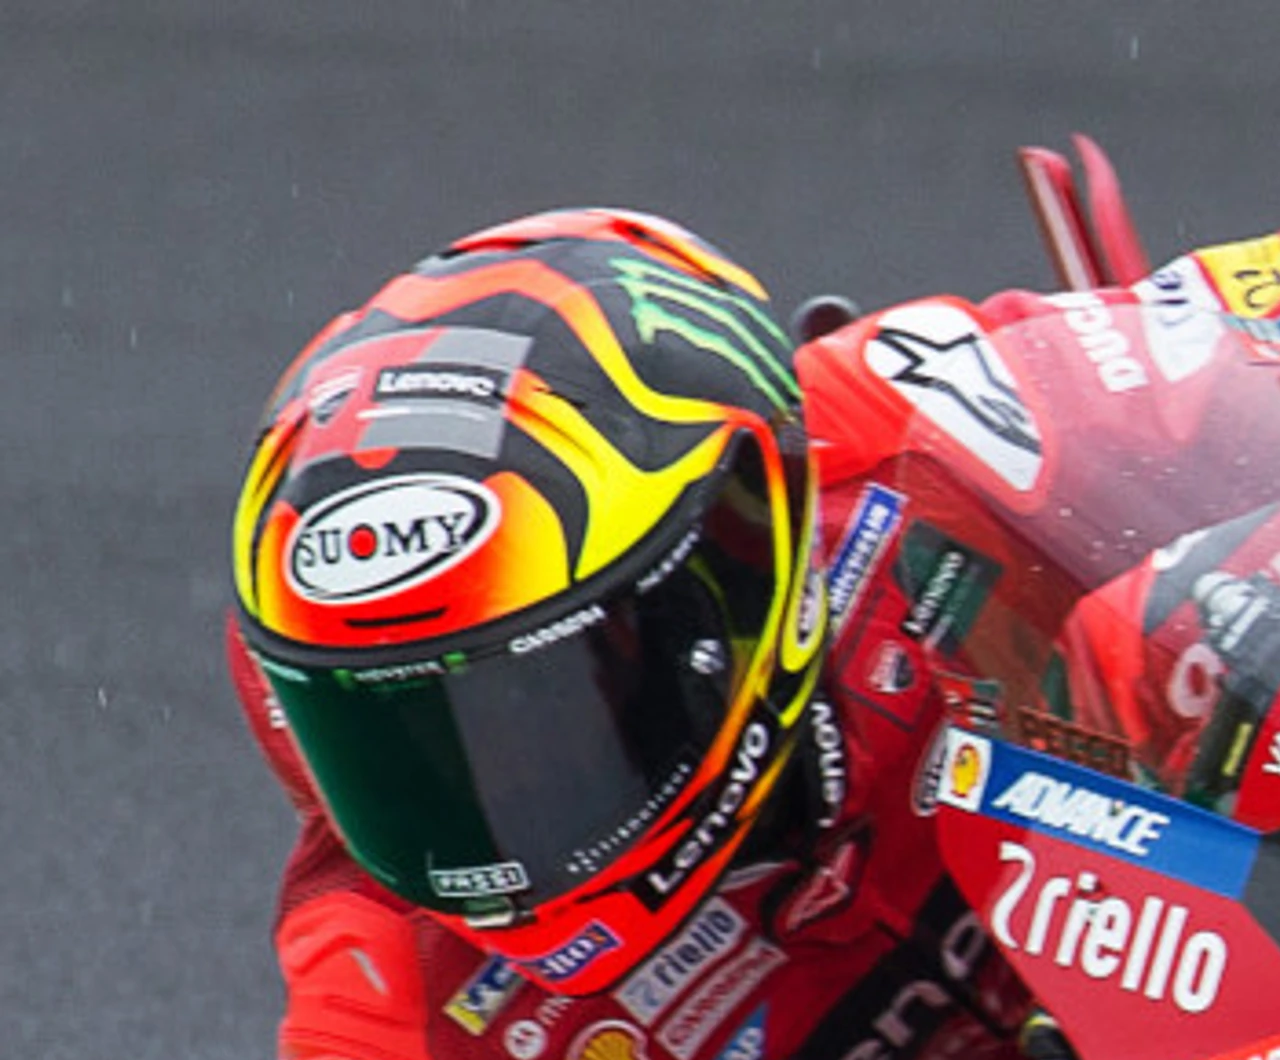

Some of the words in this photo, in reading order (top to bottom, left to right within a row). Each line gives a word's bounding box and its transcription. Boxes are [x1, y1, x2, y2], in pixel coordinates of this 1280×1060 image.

[377, 370, 496, 397] Lenovo
[298, 511, 466, 567] SUOMY
[903, 551, 964, 634] Lenovo
[648, 722, 770, 893] Lenovo
[991, 771, 1171, 856] ADVANCE
